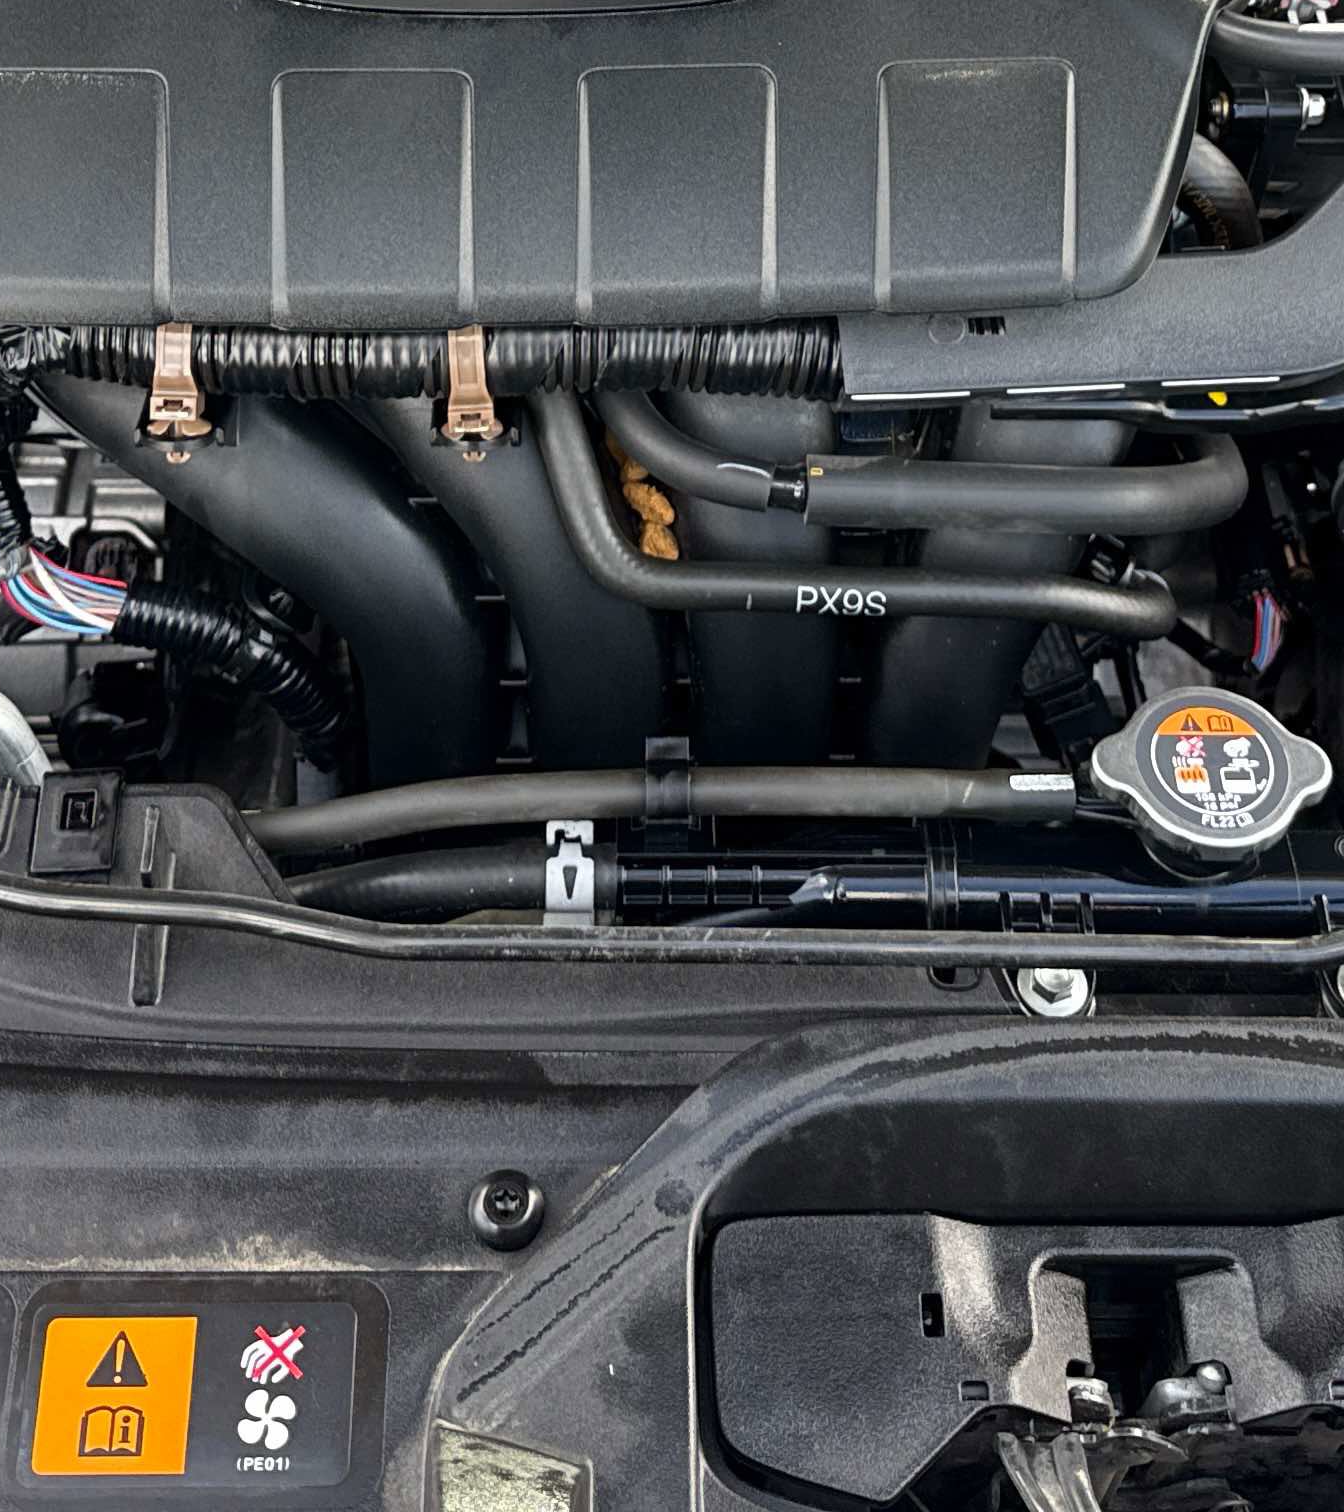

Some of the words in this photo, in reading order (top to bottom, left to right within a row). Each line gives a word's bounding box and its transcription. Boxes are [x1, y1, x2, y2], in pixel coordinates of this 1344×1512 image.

[795, 584, 887, 617] PX9S
[1201, 813, 1236, 828] FL22
[236, 1456, 291, 1472] (PE01)
